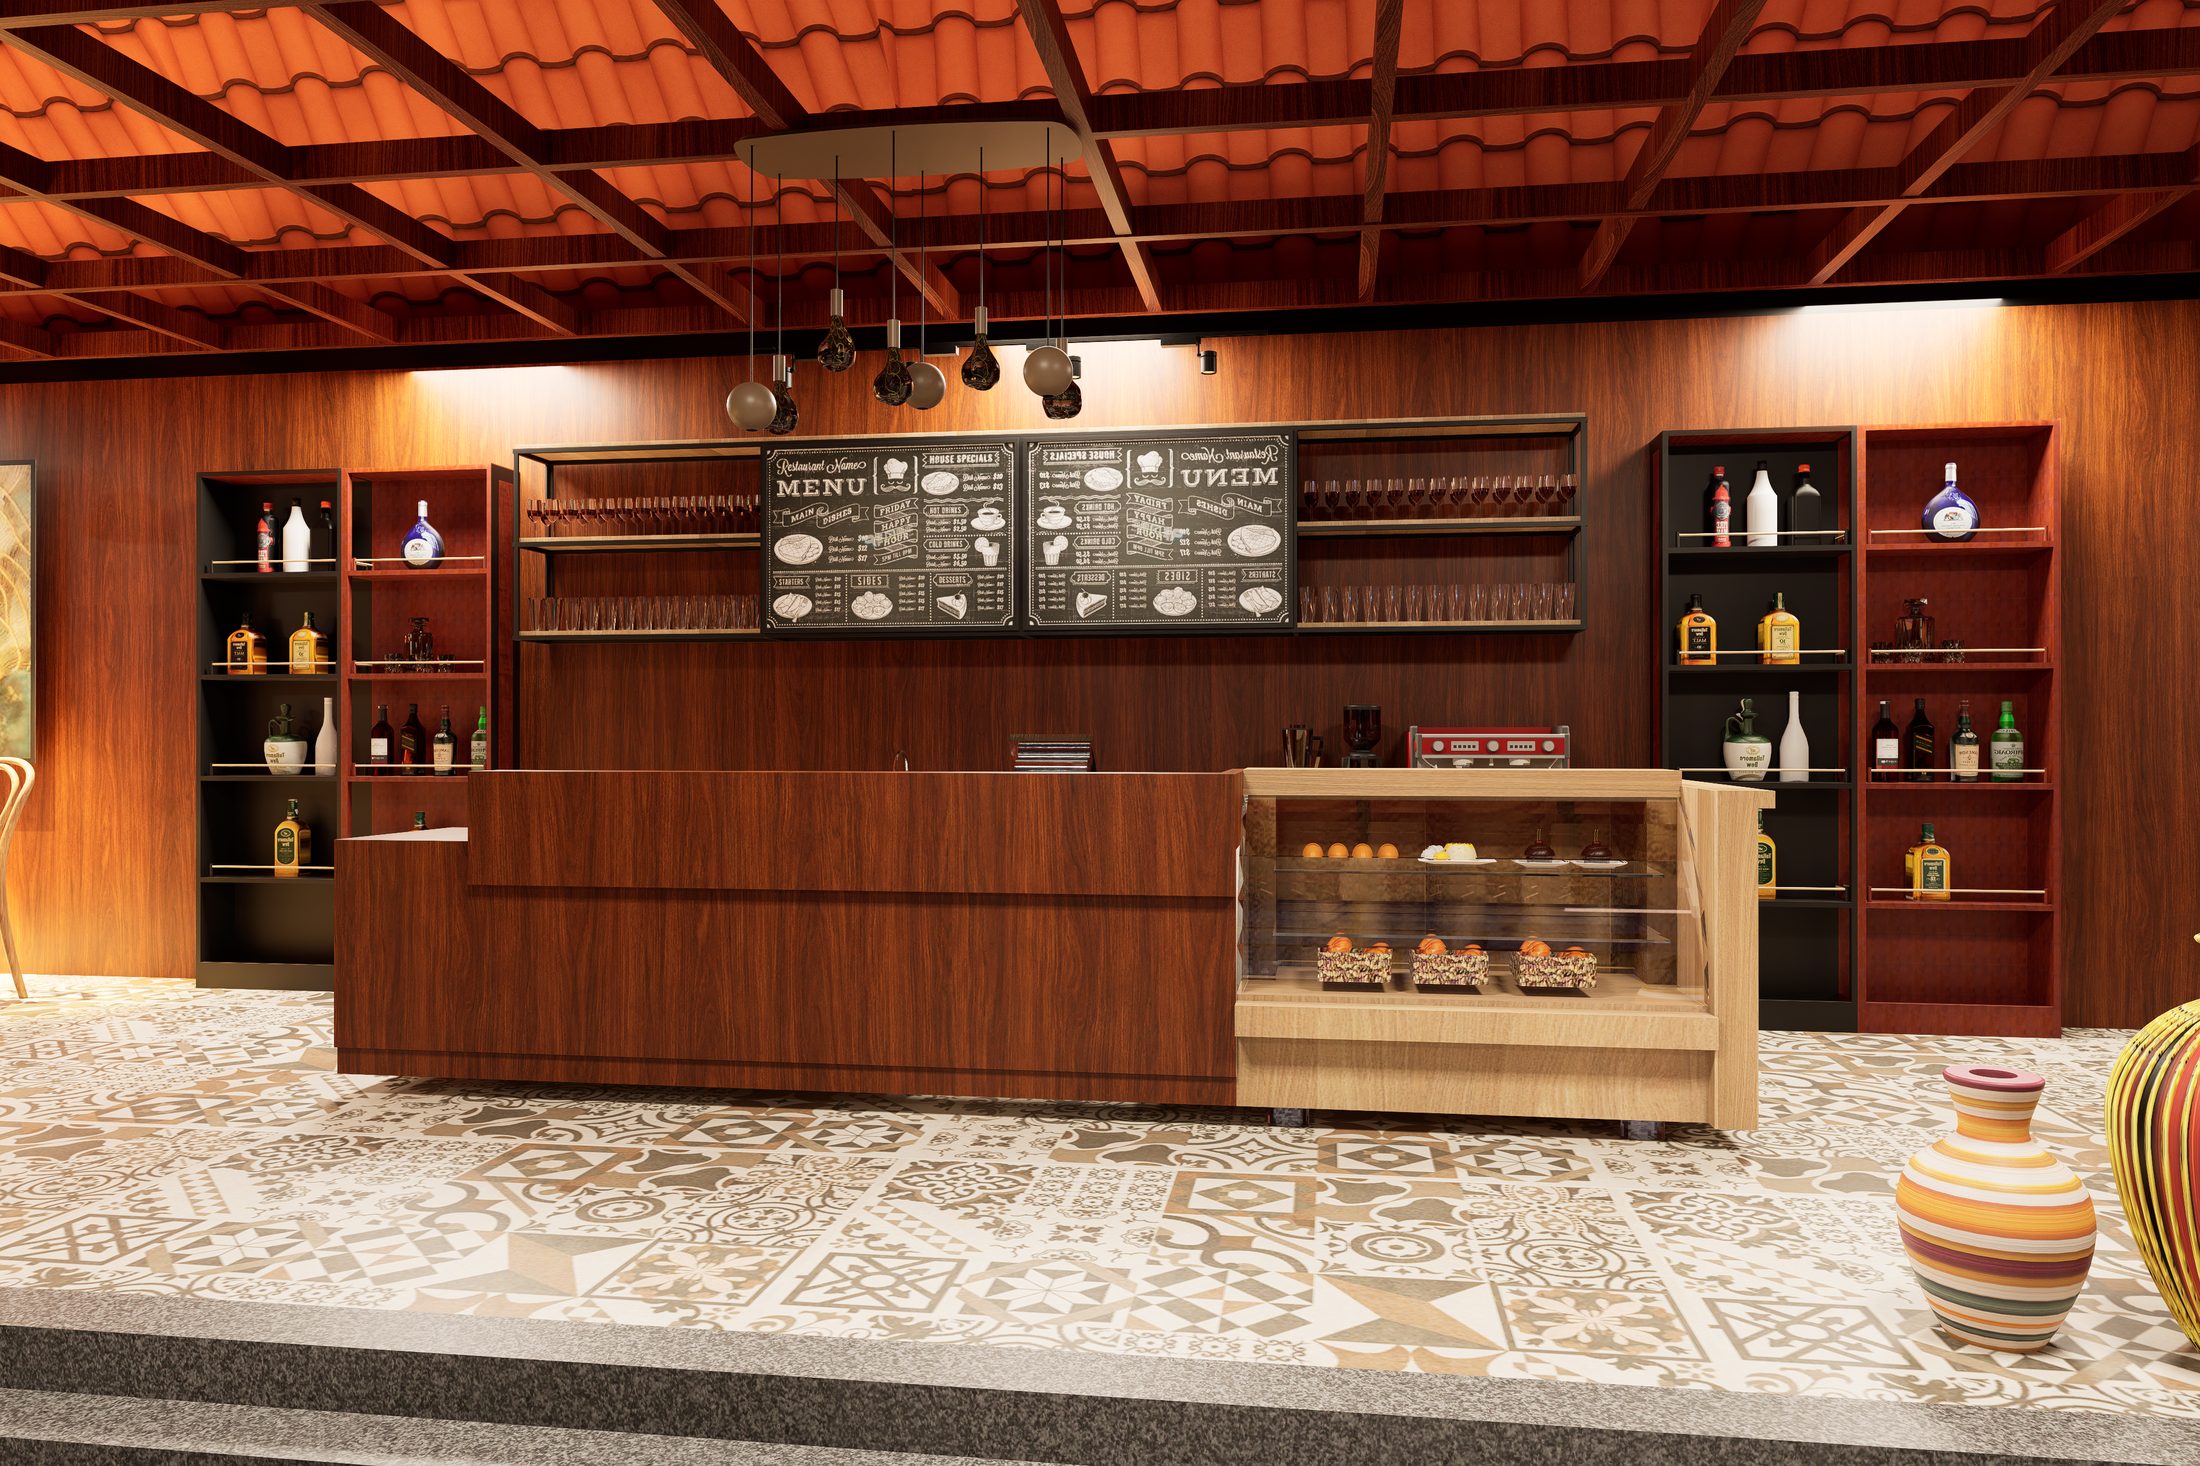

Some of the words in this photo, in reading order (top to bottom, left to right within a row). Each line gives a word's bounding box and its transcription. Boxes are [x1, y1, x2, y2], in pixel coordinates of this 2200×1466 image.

[929, 455, 954, 464] HOUSE
[957, 454, 993, 464] SPECIALS
[776, 458, 824, 477] Restaurant
[827, 457, 866, 474] Name
[776, 478, 867, 497] MENU
[880, 500, 911, 516] FRIDAY
[942, 506, 962, 514] DRINKS
[791, 507, 814, 523] MAIN
[823, 507, 852, 525] DISHES
[882, 516, 911, 530] HAPPY
[884, 532, 909, 546] HOUR
[944, 540, 963, 548] DRINKS
[779, 578, 804, 586] STARTERS
[857, 577, 882, 586] SIDES
[939, 576, 966, 584] DESSERTS
